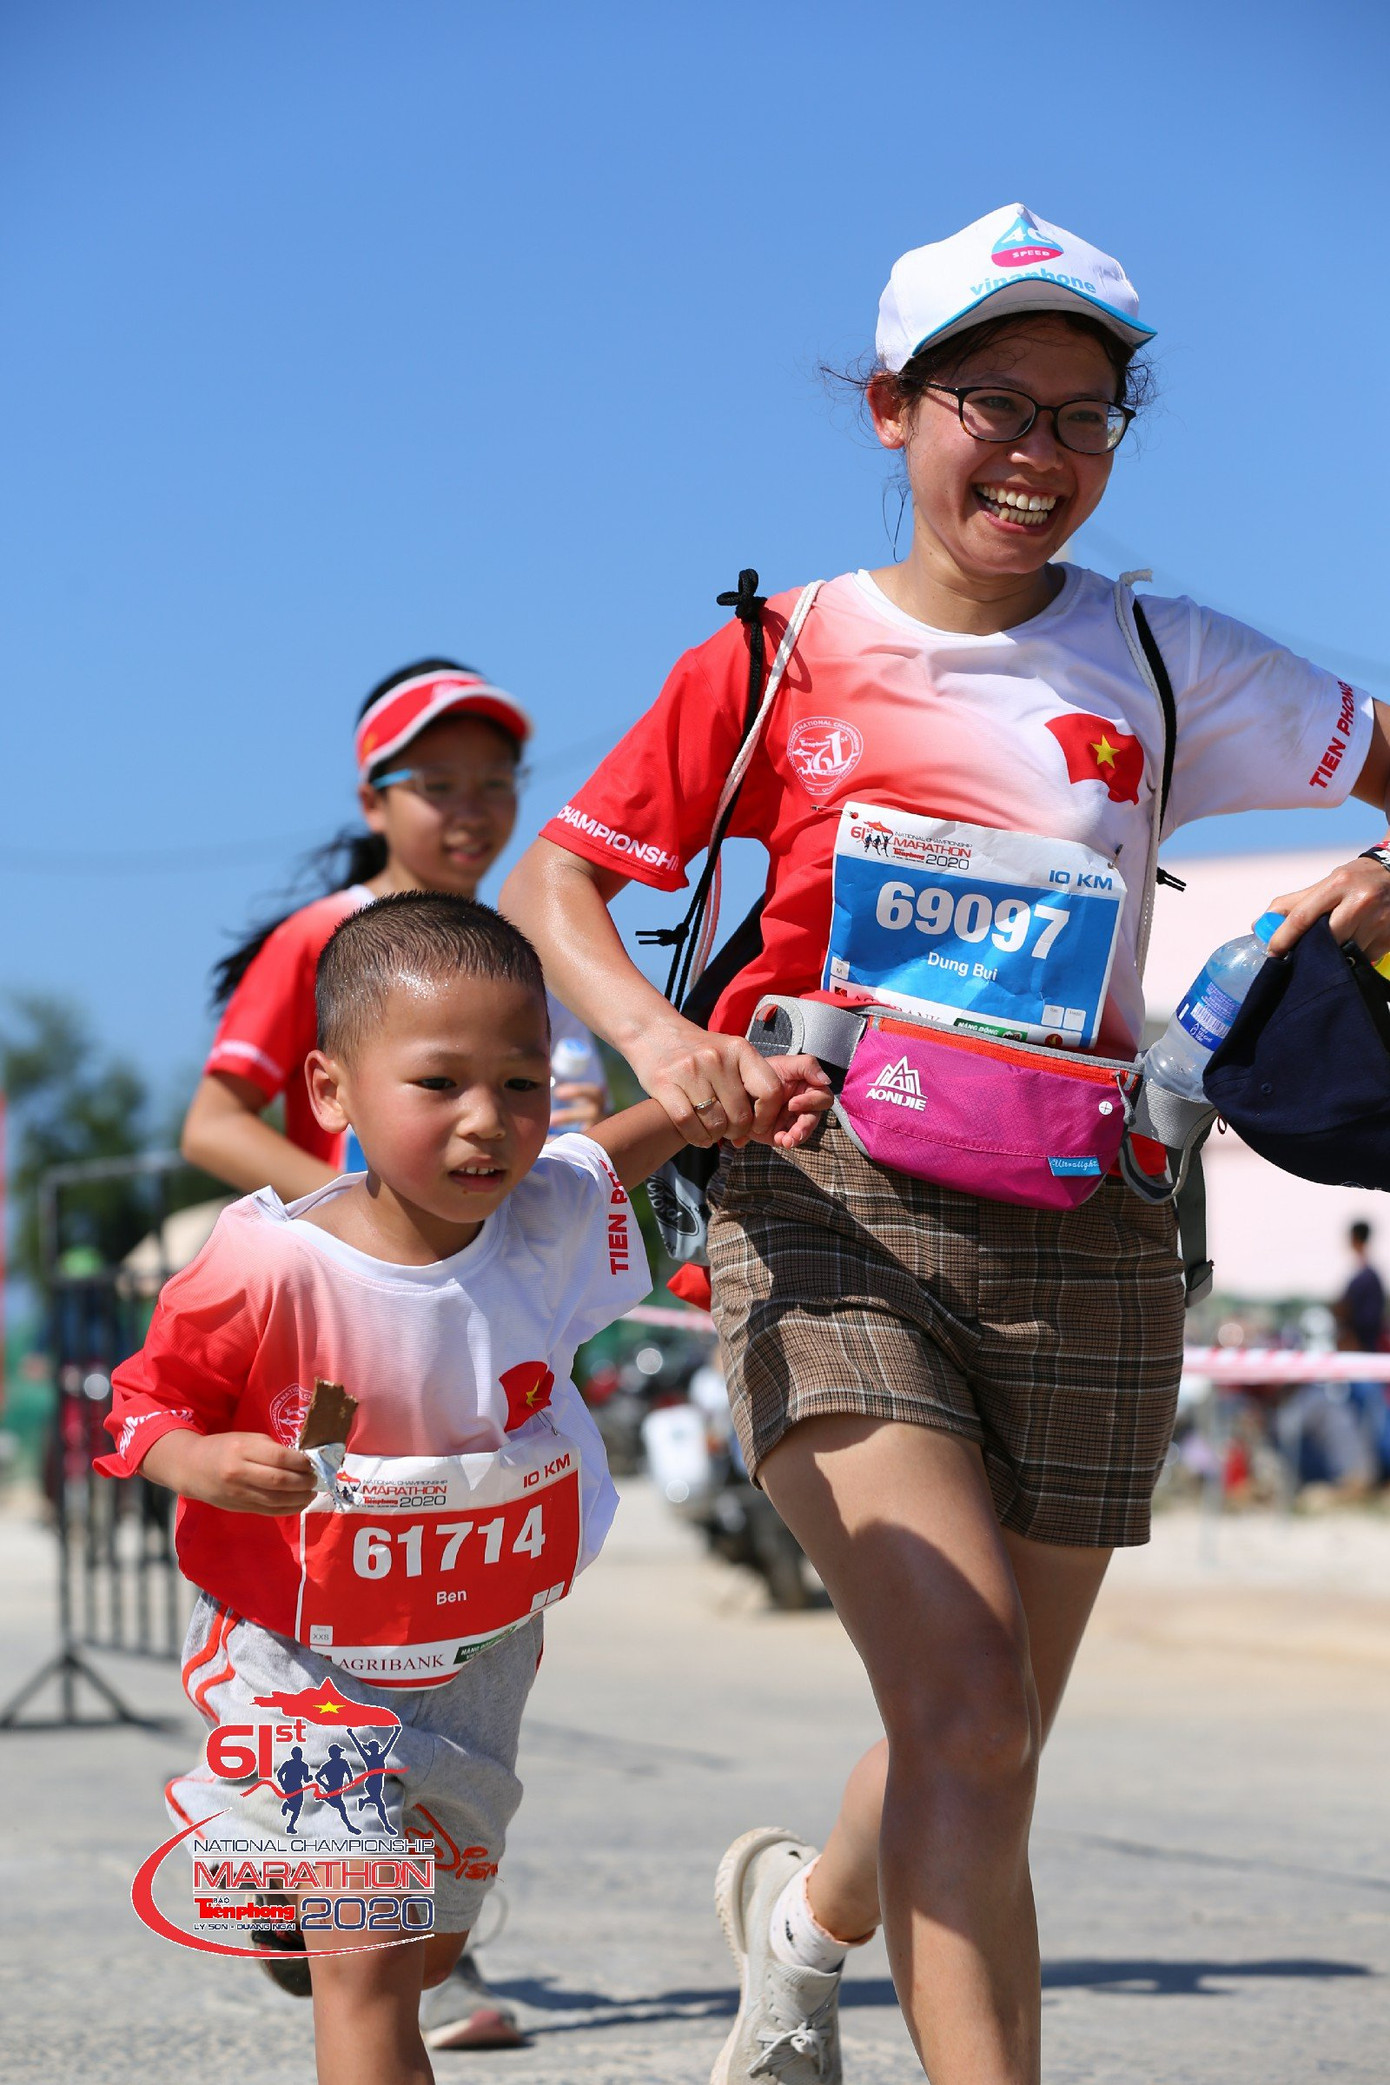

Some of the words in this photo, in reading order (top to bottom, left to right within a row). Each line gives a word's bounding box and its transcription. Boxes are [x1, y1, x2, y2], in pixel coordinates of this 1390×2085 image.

[1012, 250, 1050, 259] SPEED
[1309, 736, 1347, 789] TIEN
[557, 804, 679, 871] CHAMPIONSHI
[893, 837, 972, 858] MARATHON
[925, 853, 970, 871] 2020
[1077, 874, 1113, 891] KM
[875, 881, 1070, 960] 69097
[927, 952, 967, 977] Dung
[972, 961, 998, 982] Bui
[608, 1214, 629, 1276] TIEN
[544, 1453, 571, 1477] KM
[362, 1485, 447, 1496] MARATHON
[399, 1495, 447, 1508] 2020
[352, 1504, 546, 1580] 61714
[436, 1590, 467, 1605] Ben
[339, 1654, 445, 1671] AGRIBANK
